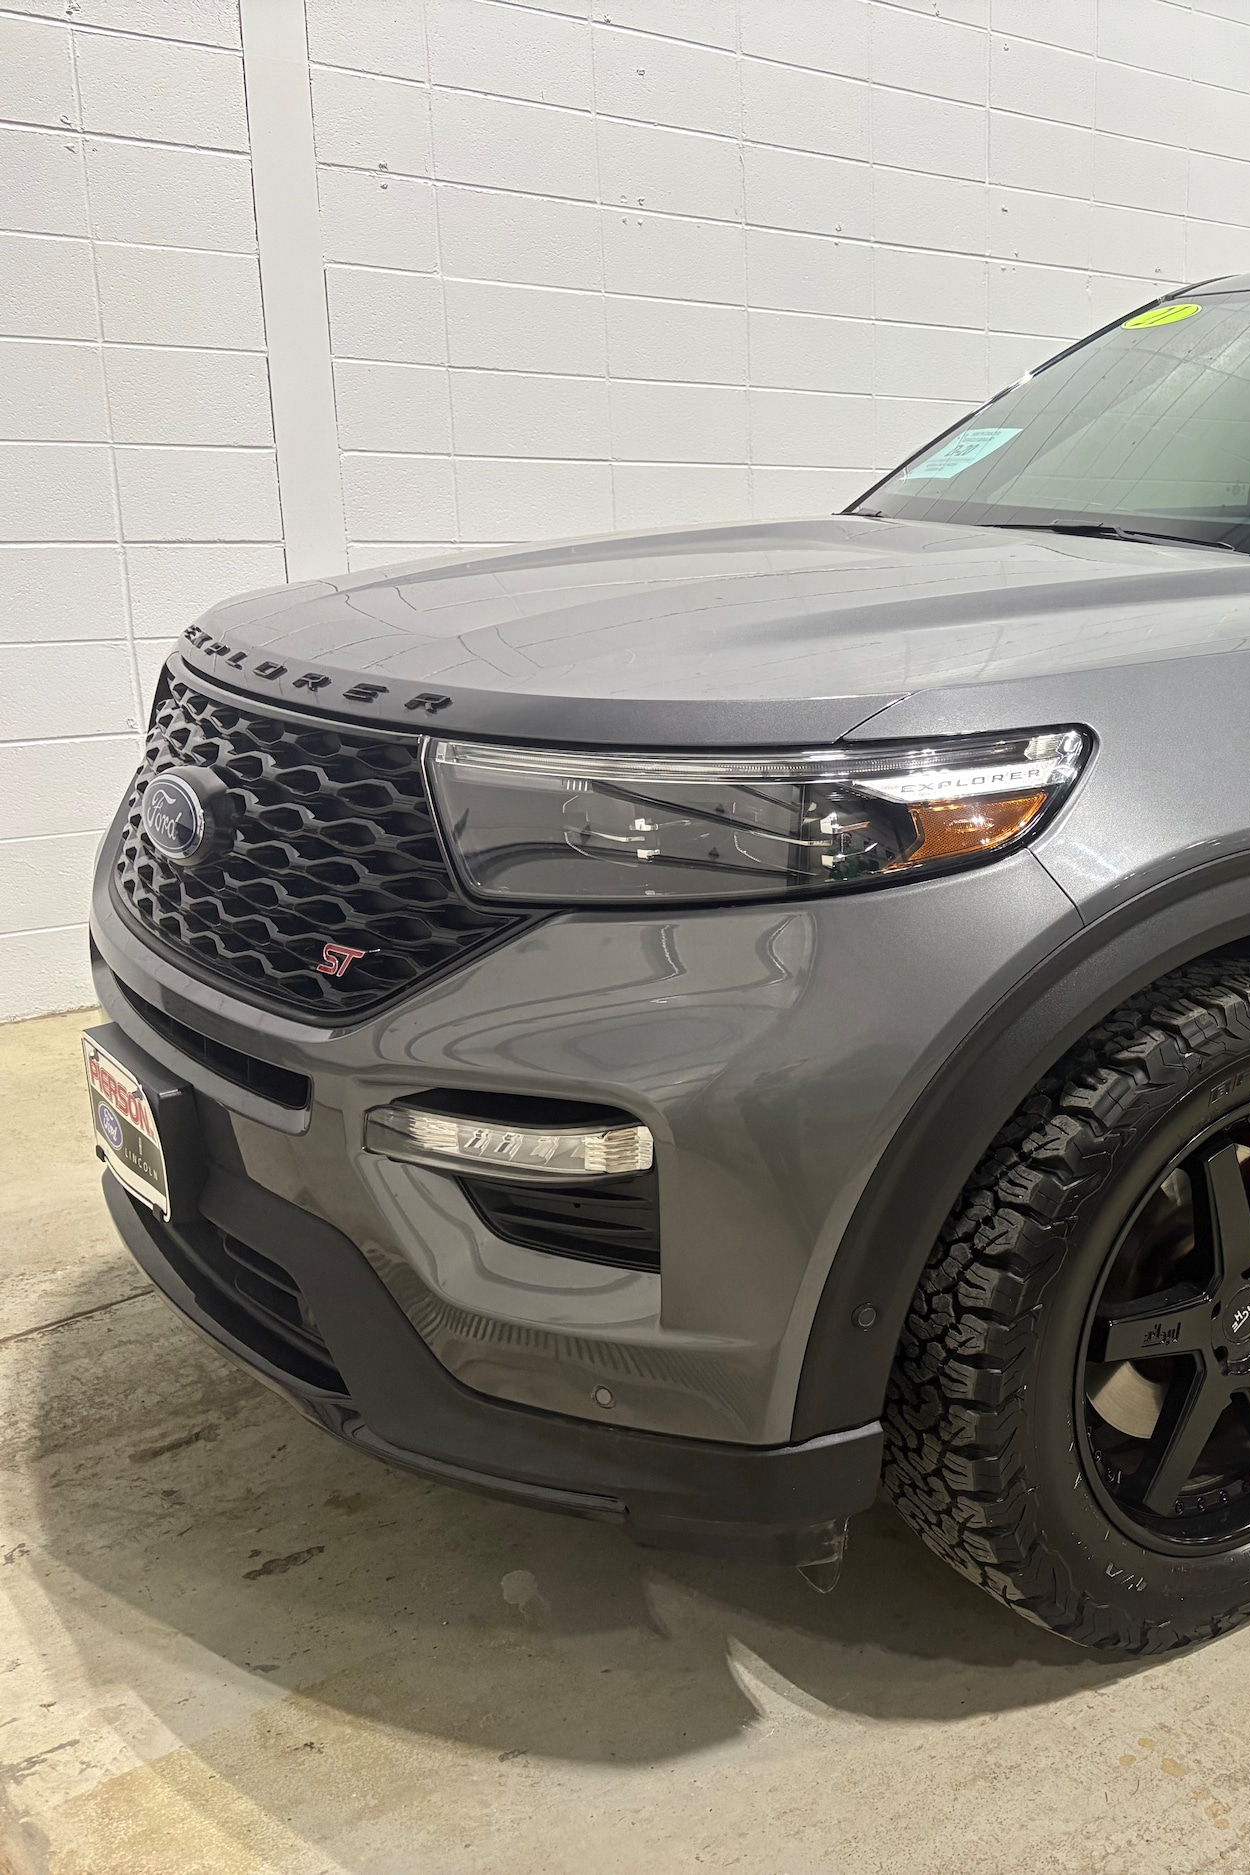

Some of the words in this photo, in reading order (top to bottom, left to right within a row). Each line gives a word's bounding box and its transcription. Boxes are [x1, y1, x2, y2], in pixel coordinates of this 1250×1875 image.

[183, 624, 453, 715] EXPLORER
[901, 769, 1040, 794] EXPLORER
[147, 789, 183, 841] Ford
[316, 943, 366, 977] ST
[89, 1057, 152, 1138] PIERSON
[124, 1147, 159, 1181] LINCOLN
